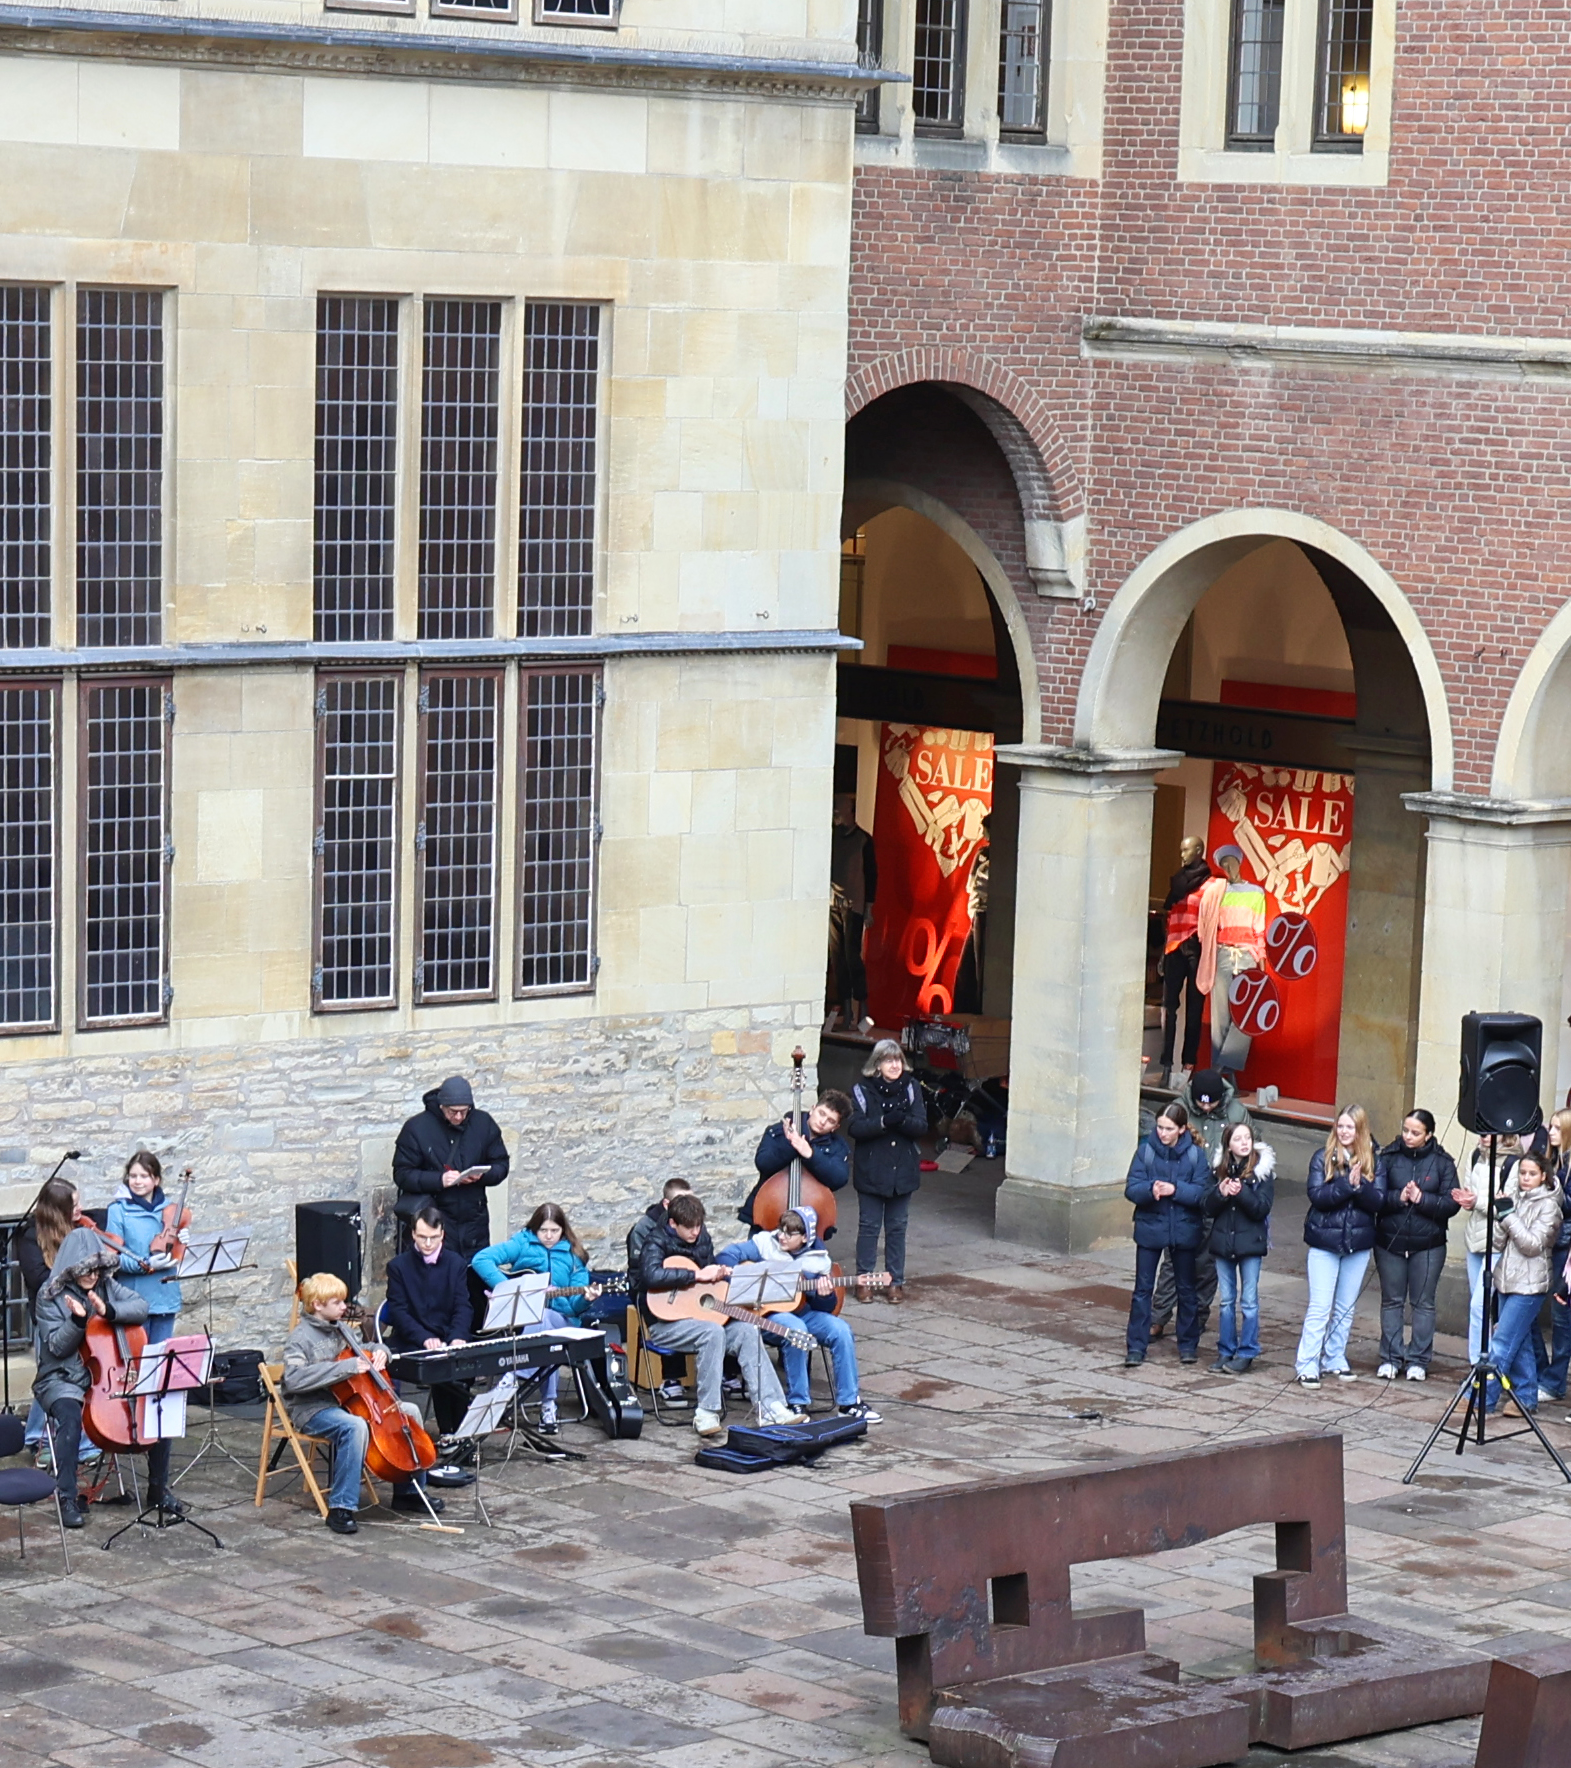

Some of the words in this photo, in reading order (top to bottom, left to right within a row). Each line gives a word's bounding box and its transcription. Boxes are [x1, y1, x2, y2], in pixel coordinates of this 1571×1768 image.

[915, 750, 993, 793] SALE
[1254, 791, 1345, 836] SALE
[1267, 915, 1317, 977] %
[1229, 972, 1280, 1032] %
